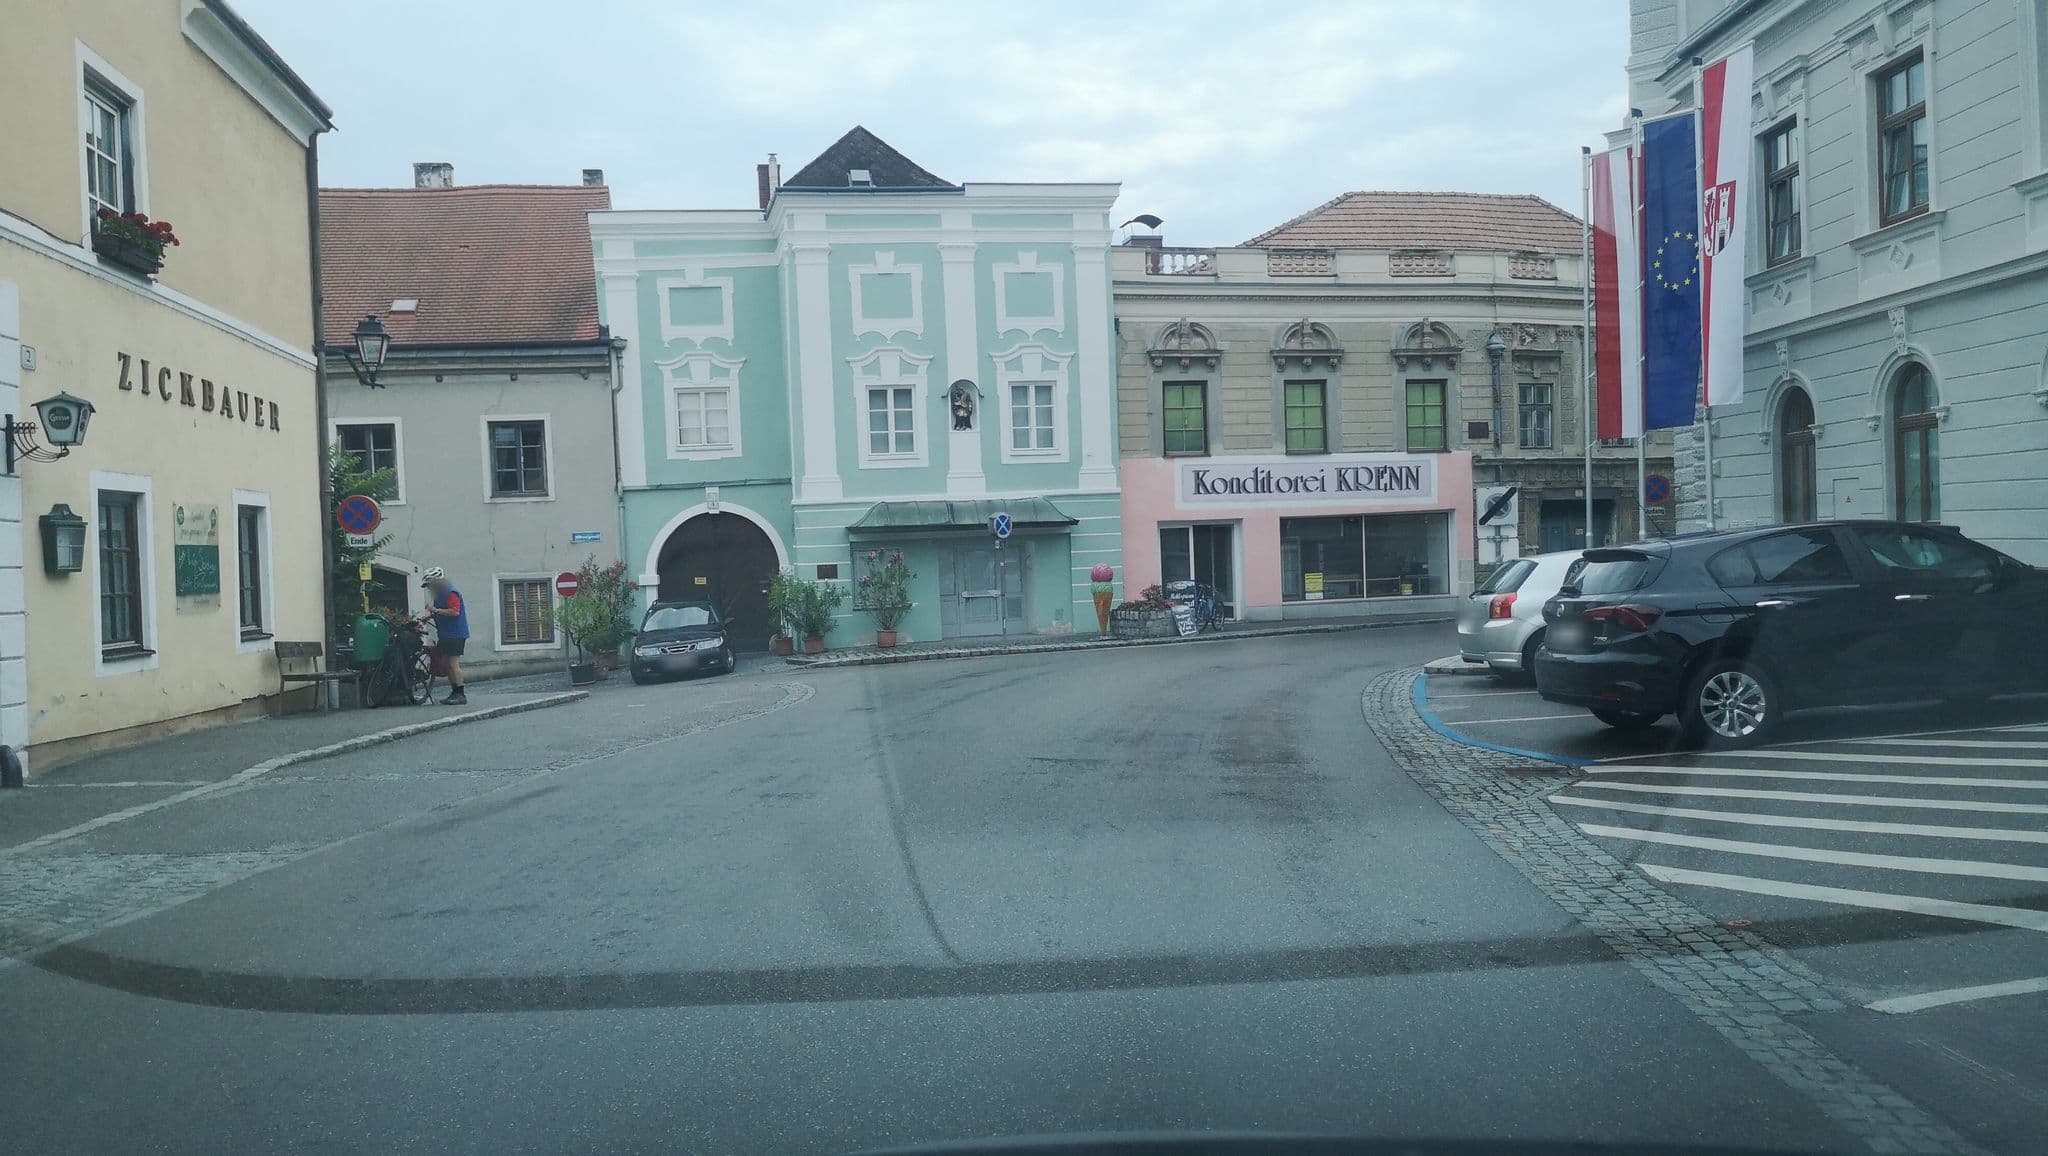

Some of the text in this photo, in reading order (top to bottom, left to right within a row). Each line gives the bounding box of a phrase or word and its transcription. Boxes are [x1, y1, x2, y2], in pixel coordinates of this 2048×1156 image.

[117, 351, 281, 432] ZICKBAUER
[1192, 464, 1422, 495] Konditorei KRENN
[351, 537, 368, 545] Ende
